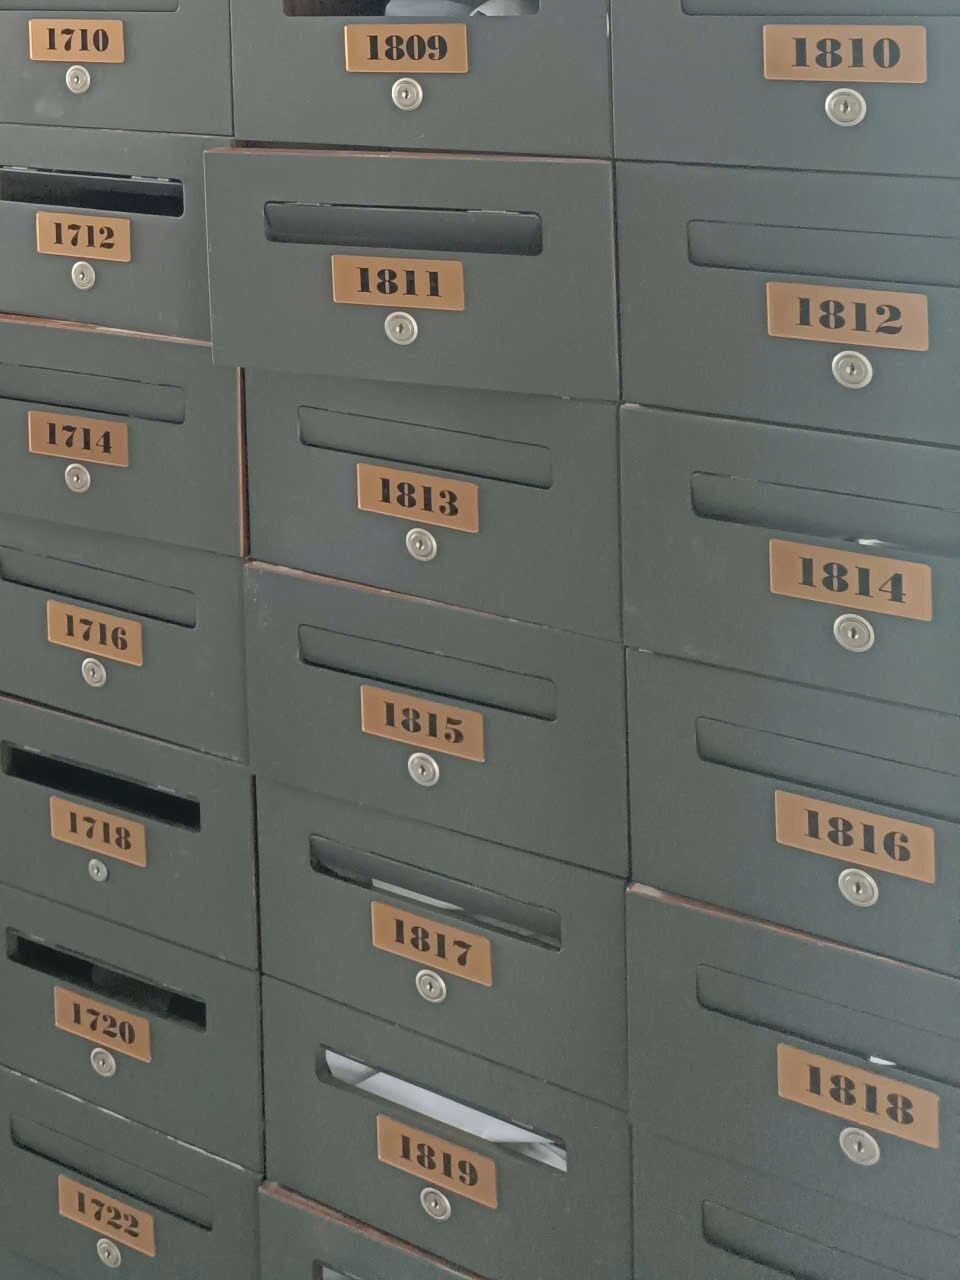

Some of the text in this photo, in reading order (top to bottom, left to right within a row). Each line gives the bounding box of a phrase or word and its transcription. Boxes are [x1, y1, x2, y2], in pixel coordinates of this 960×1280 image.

[47, 28, 109, 52] 1710
[367, 34, 448, 61] 1809
[791, 37, 901, 69] 1810
[54, 222, 115, 248] 1712
[357, 267, 442, 298] 1811
[796, 297, 902, 333] 1812
[48, 422, 113, 454] 1714
[380, 477, 459, 517] 1813
[798, 556, 906, 604] 1814
[66, 614, 128, 651] 1716
[384, 701, 464, 744] 1815
[70, 811, 132, 850] 1718
[804, 808, 911, 862] 1816
[394, 918, 472, 967] 1817
[73, 1002, 136, 1045] 1720
[808, 1064, 914, 1125] 1818
[400, 1134, 478, 1187] 1819
[78, 1192, 140, 1237] 1722
